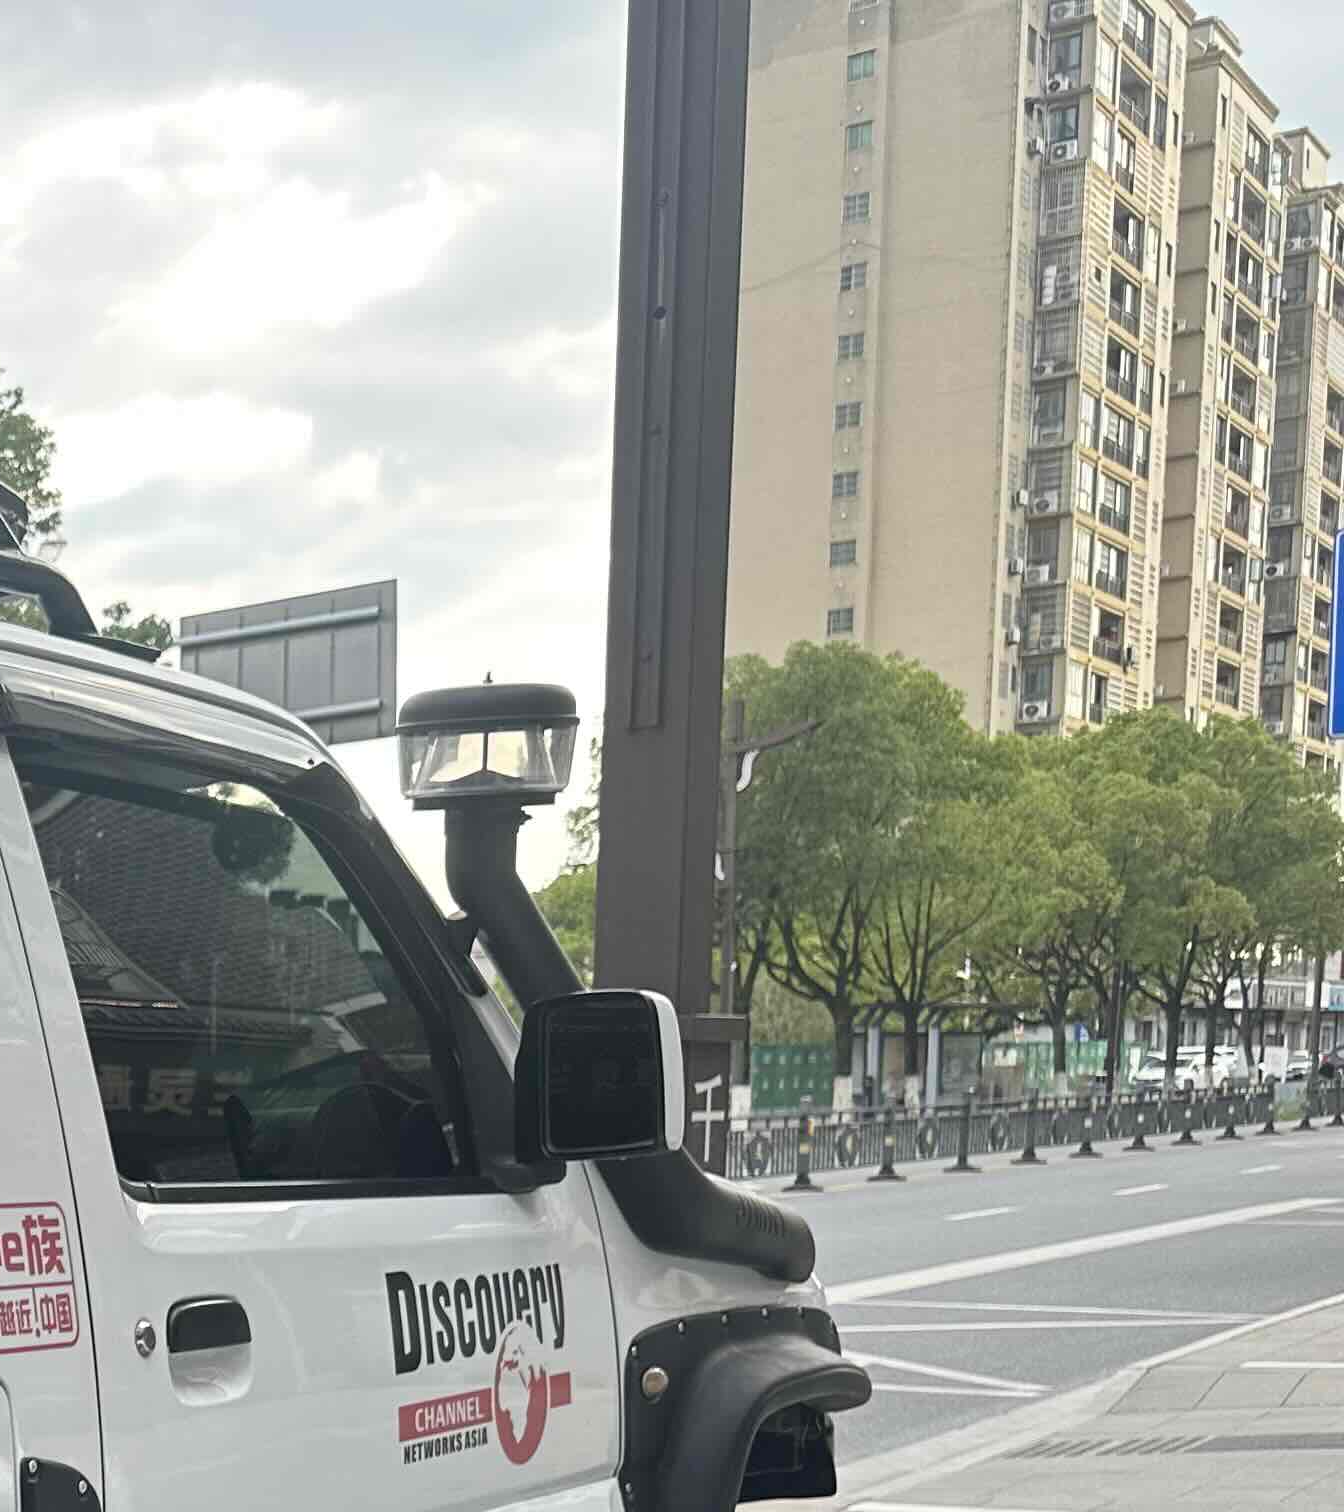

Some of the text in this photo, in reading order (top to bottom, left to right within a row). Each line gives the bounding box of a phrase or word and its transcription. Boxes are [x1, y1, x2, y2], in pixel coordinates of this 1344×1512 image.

[414, 1396, 485, 1433] CHANNEL
[403, 1427, 488, 1465] NETWORKS ASIA
